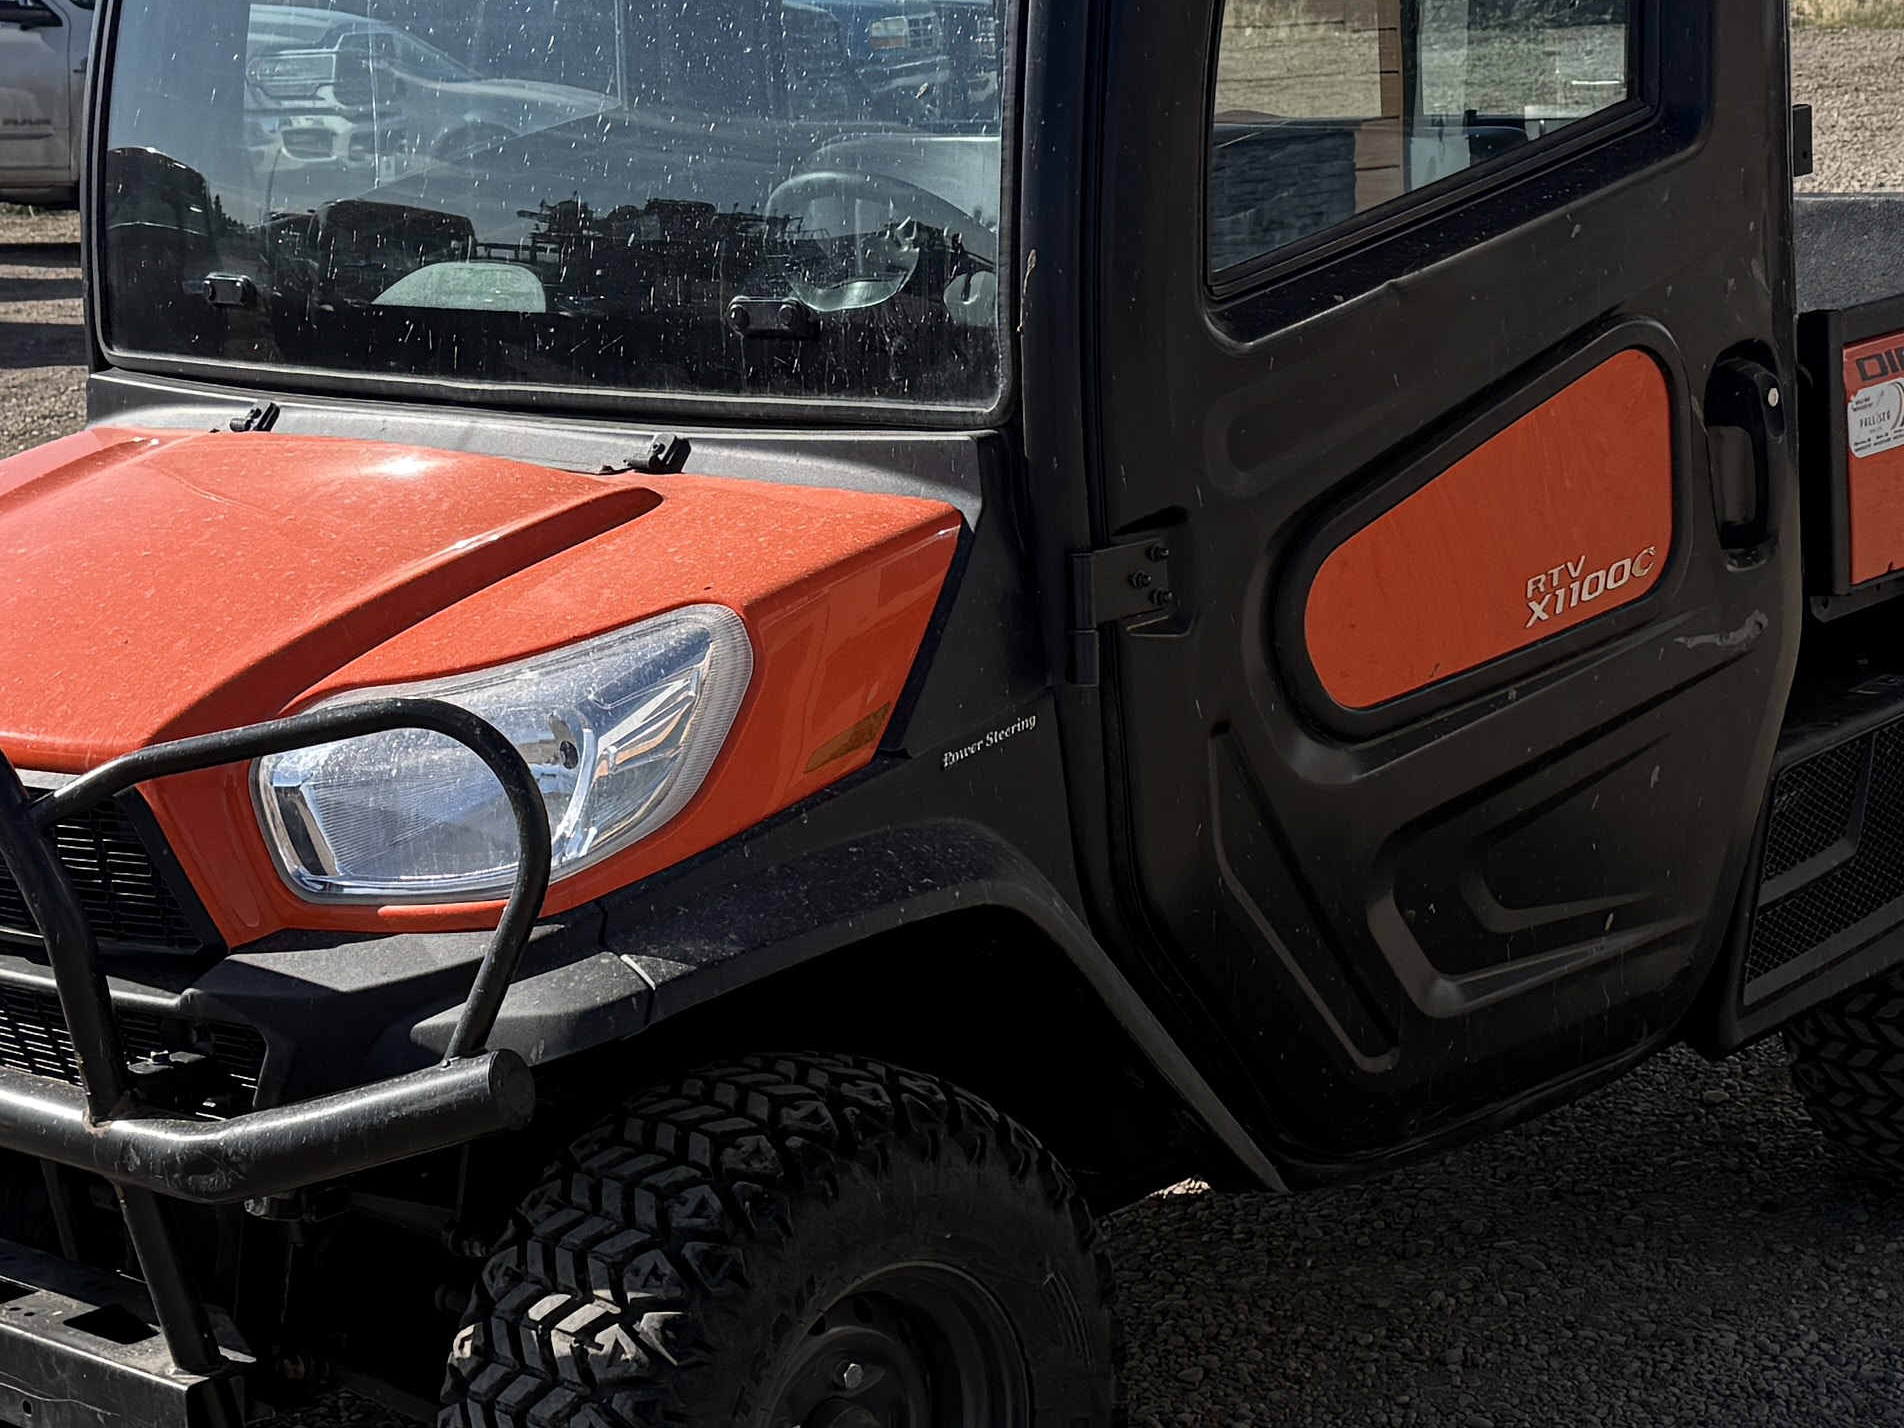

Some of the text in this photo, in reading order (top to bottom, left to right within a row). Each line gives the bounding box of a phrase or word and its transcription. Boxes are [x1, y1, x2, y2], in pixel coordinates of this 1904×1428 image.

[1525, 545, 1656, 629] X1100C
[1526, 555, 1586, 599] RTV
[942, 715, 1037, 768] Power Steering
